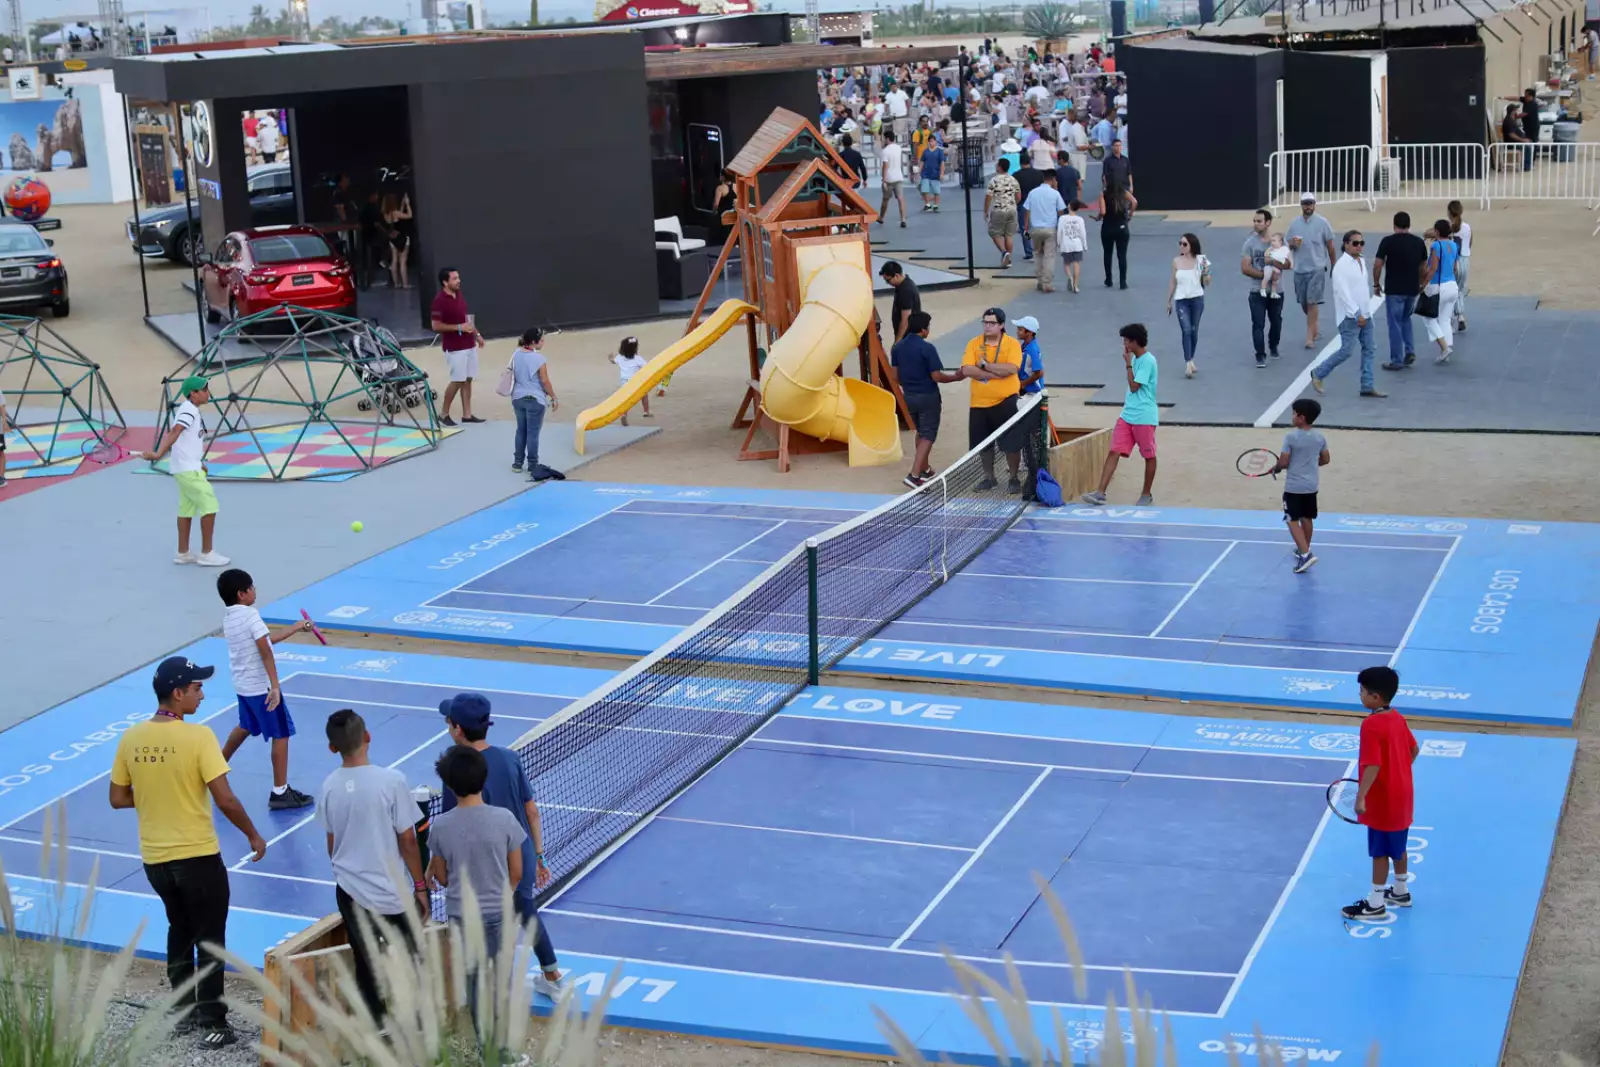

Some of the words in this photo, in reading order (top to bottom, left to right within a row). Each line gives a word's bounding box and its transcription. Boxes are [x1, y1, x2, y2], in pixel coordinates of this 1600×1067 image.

[1047, 507, 1161, 518] LOVE
[427, 552, 477, 570] LOS
[469, 523, 540, 550] CABOS
[1487, 569, 1522, 591] LOS
[1469, 592, 1513, 634] CABOS
[274, 651, 328, 662] éxico
[888, 649, 1005, 668] LIVE
[1396, 688, 1471, 700] Méxic
[812, 694, 963, 720] LOVE
[48, 712, 154, 761] CABOS
[134, 746, 176, 755] KORAL
[134, 755, 165, 763] KIDS
